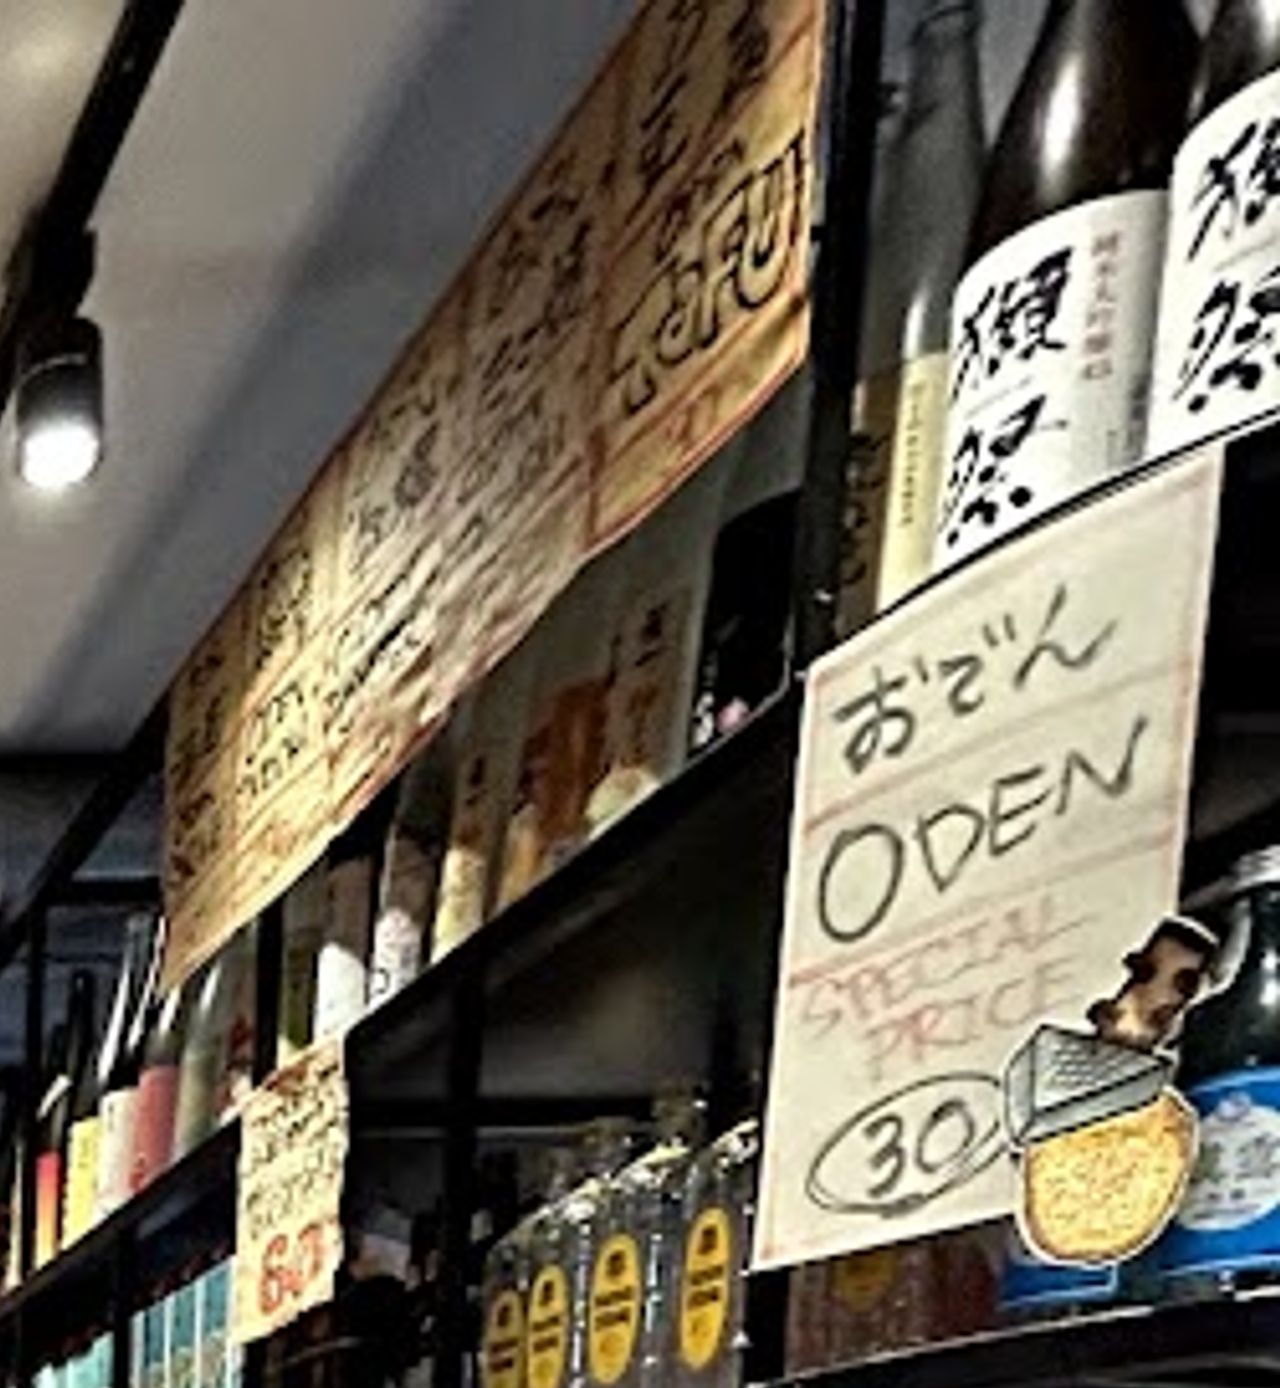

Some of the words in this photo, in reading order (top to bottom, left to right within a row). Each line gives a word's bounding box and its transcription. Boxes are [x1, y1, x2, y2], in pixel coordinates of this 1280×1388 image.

[831, 583, 1117, 777] おでん
[819, 716, 1148, 943] ODEN
[801, 893, 1102, 1042] SPECIAL
[866, 955, 1086, 1083] PRICE
[862, 1098, 976, 1198] 30
